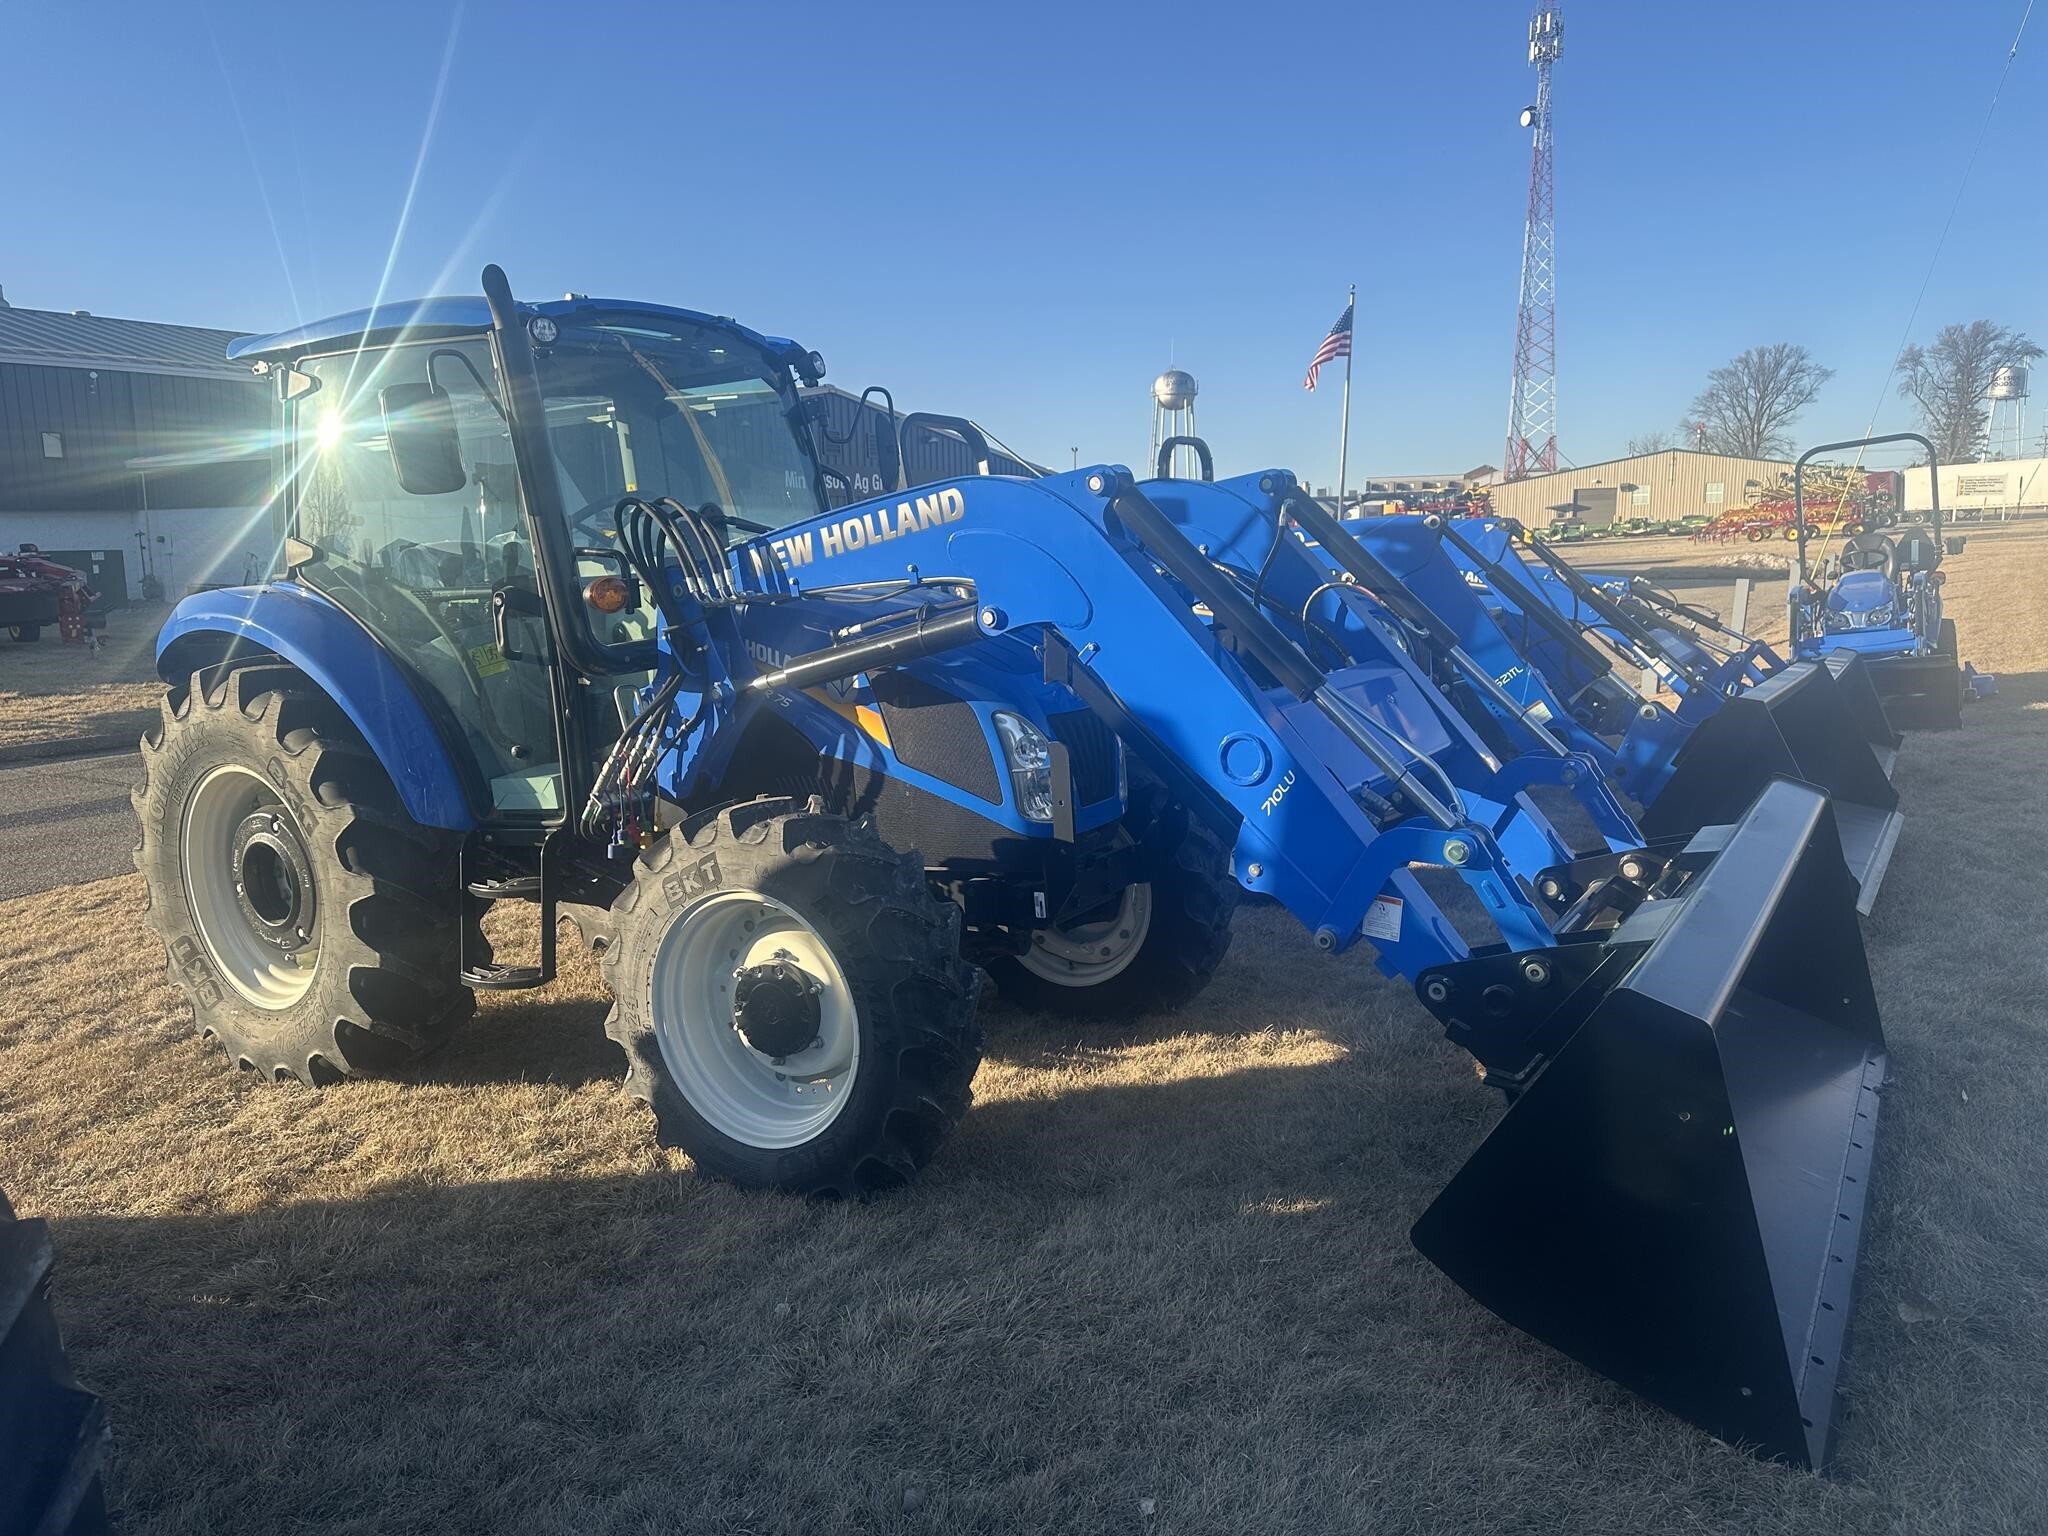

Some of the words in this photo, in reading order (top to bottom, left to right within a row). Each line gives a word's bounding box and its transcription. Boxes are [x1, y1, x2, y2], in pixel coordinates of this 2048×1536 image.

[854, 473, 869, 494] Ag
[749, 531, 814, 577] NEW
[820, 487, 966, 558] HOLLAND
[1261, 769, 1297, 817] 710LU
[663, 856, 719, 904] BKT
[172, 939, 221, 1009] BKT
